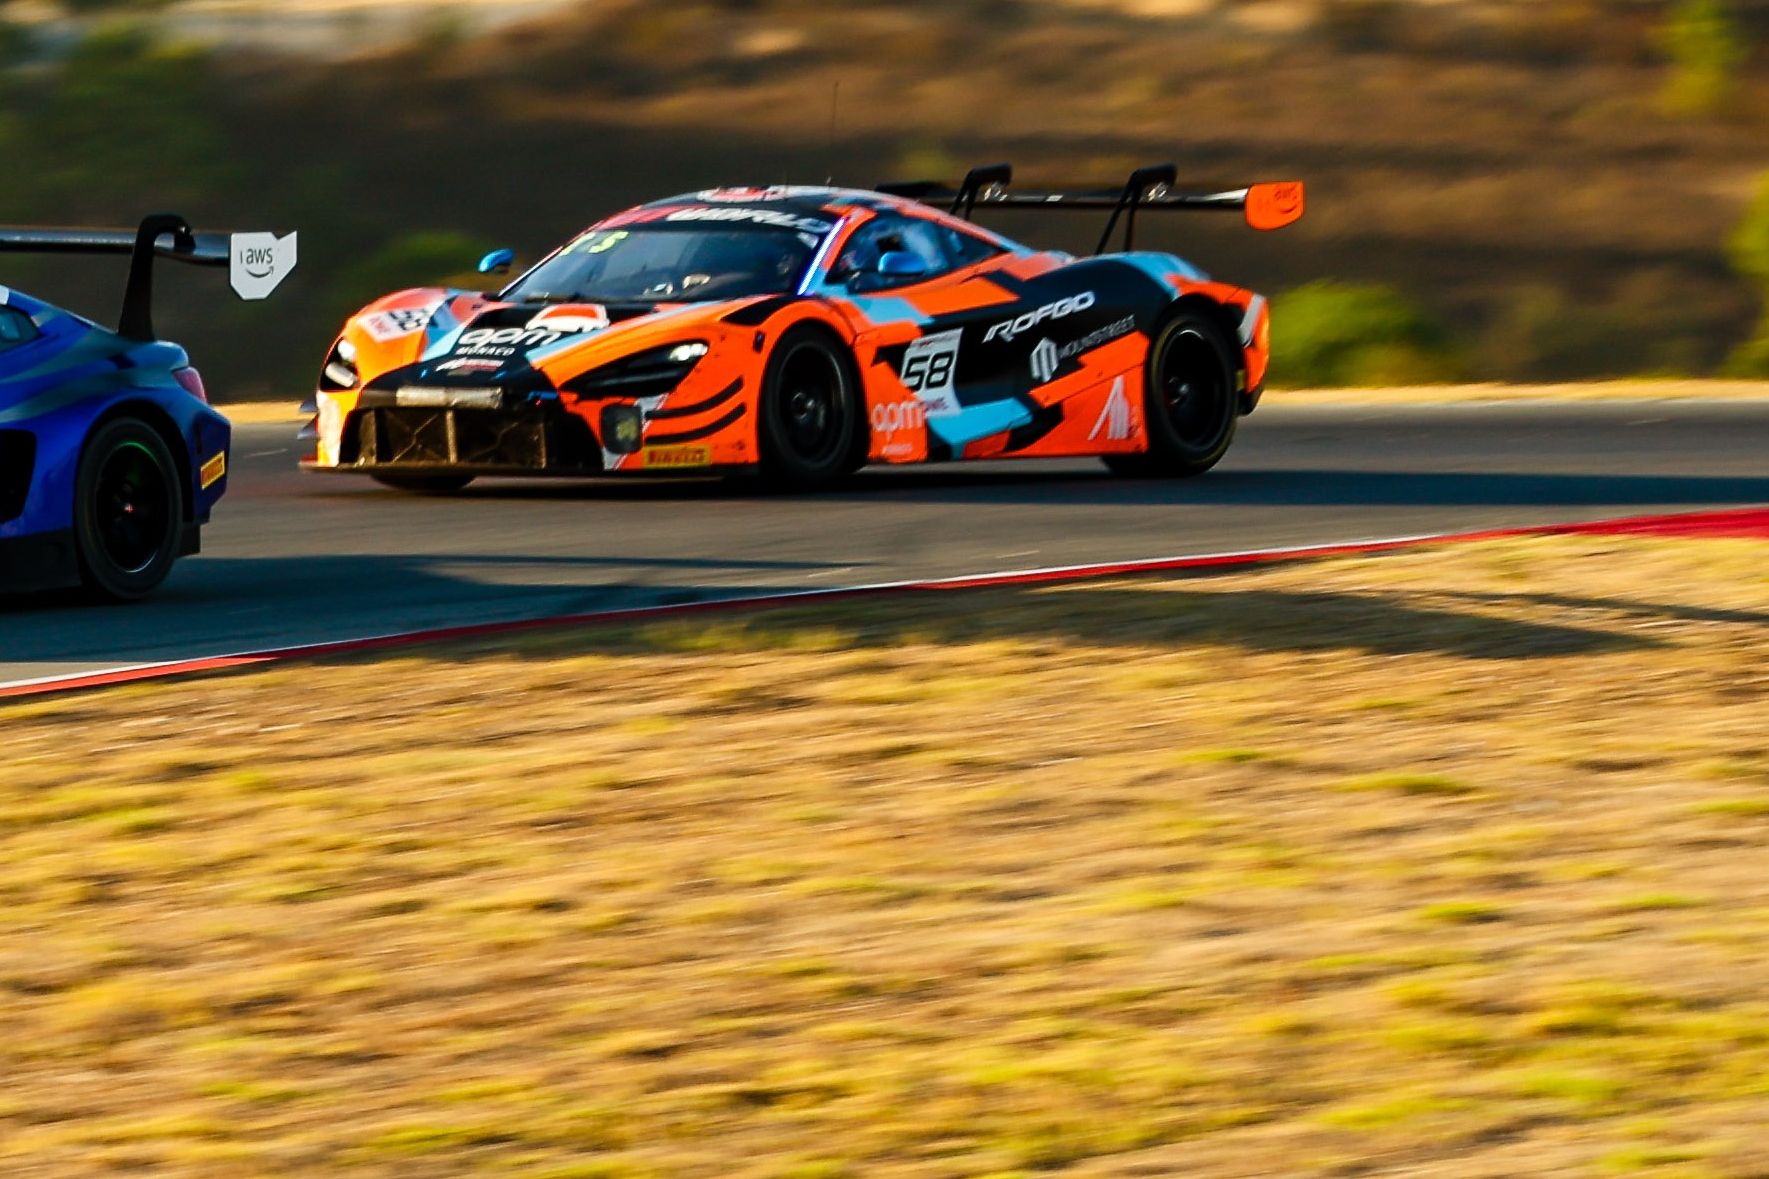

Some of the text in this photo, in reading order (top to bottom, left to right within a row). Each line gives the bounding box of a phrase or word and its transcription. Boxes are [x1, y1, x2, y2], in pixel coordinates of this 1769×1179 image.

[246, 248, 273, 265] aws
[982, 290, 1096, 344] ROFGO
[903, 351, 955, 392] 58
